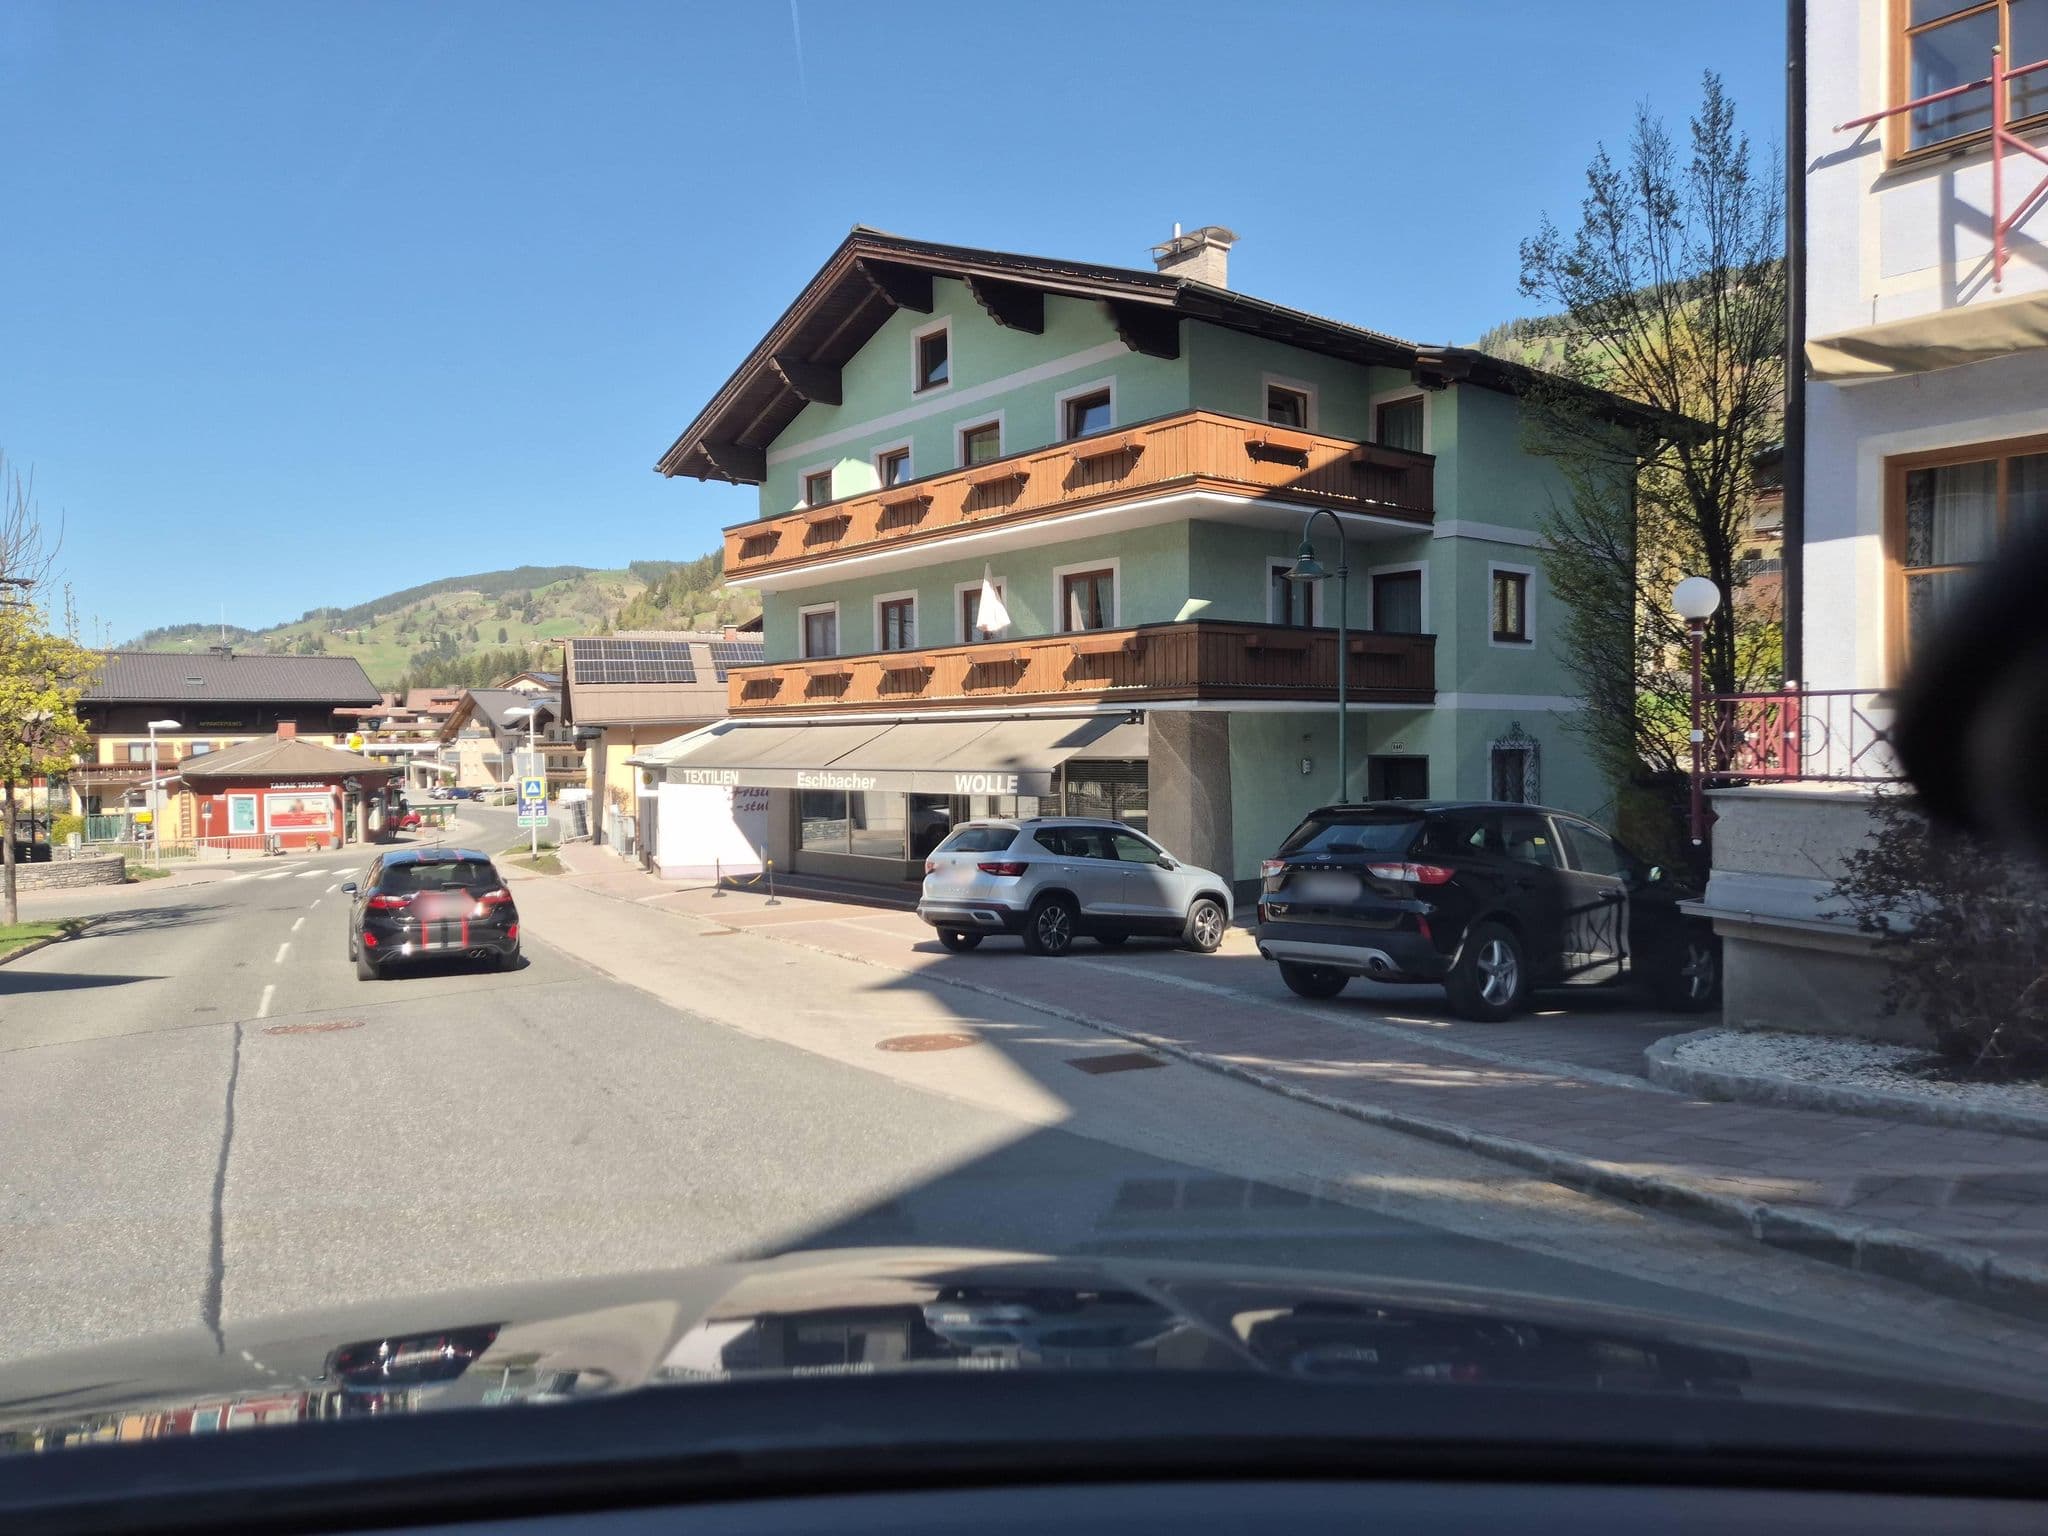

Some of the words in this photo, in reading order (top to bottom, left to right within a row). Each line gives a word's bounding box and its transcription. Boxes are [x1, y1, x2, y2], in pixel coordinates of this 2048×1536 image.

[683, 769, 739, 785] TEXTILIEN
[797, 771, 877, 790] Eschbacher
[954, 774, 1019, 794] WOLLE
